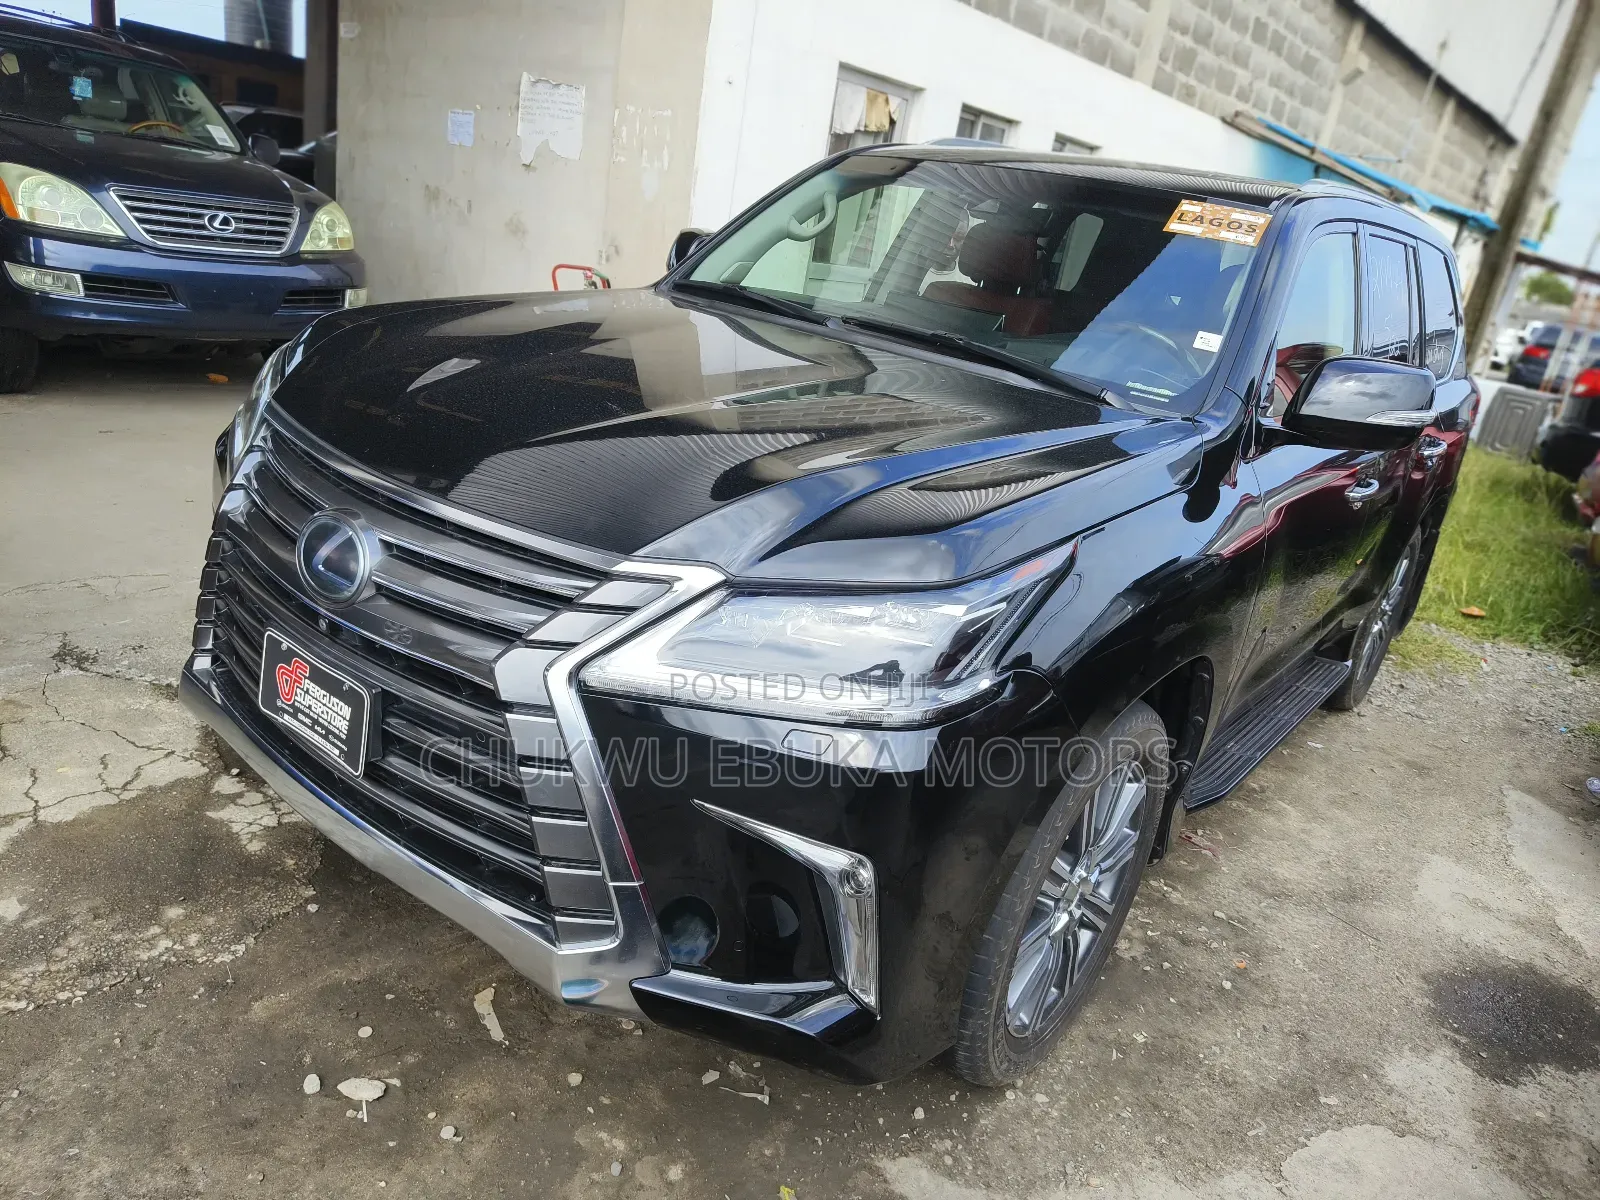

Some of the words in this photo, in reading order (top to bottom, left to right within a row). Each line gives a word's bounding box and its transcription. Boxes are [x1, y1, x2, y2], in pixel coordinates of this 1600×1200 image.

[1176, 211, 1258, 234] LAGOS
[294, 687, 349, 735] SUPERSTORE
[303, 678, 352, 721] FERGUSON
